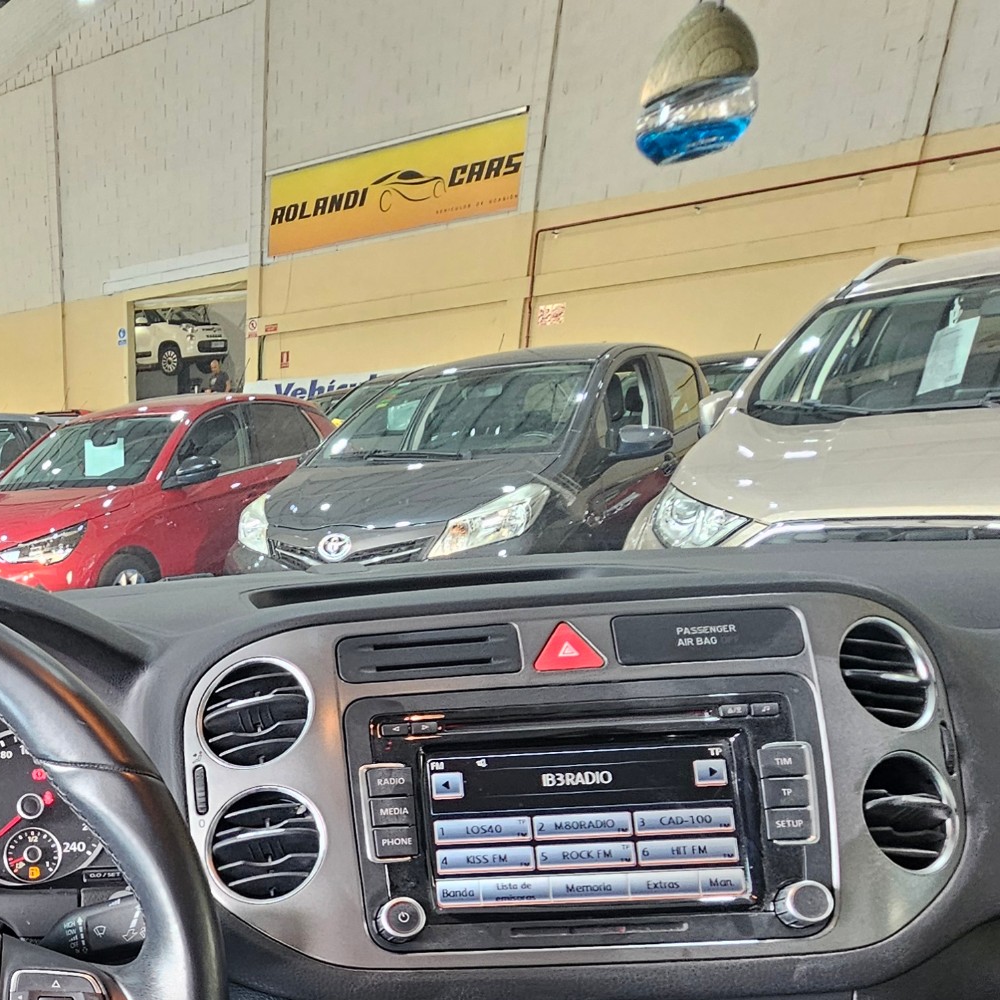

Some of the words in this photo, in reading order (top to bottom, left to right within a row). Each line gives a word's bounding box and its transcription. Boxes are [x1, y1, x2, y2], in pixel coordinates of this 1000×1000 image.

[270, 187, 369, 226] ROLANDI
[448, 152, 525, 188] CARS
[676, 624, 737, 635] PASSENGER
[677, 637, 694, 647] AIR
[696, 636, 718, 646] BAG
[0, 751, 13, 759] 80
[708, 747, 723, 756] TP
[430, 761, 445, 770] FM
[774, 757, 793, 766] TIM
[377, 777, 406, 786] RADIO
[541, 771, 613, 787] IB3RADIO
[781, 788, 793, 796] TP
[379, 807, 409, 816] MEDIA
[538, 822, 545, 832] 2
[554, 819, 615, 831] M80RADIO
[639, 818, 646, 827] 3
[659, 815, 713, 826] CAD-100
[775, 819, 804, 829] SETUP
[440, 827, 445, 836] 1
[466, 824, 503, 835] LOS40
[63, 841, 86, 853] 240
[381, 837, 412, 847] PHONE
[541, 853, 548, 862] 5
[562, 850, 594, 861] ROCK
[597, 850, 613, 859] FM
[642, 848, 650, 857] 6
[671, 846, 688, 856] HIT
[692, 845, 708, 855] FM
[441, 857, 448, 866] 4
[466, 855, 489, 865] KISS
[492, 853, 508, 863] FM
[496, 882, 518, 890] Lista
[521, 881, 532, 890] de
[566, 883, 612, 893] Memoria
[646, 879, 680, 890] Extras
[442, 888, 475, 898] Banda
